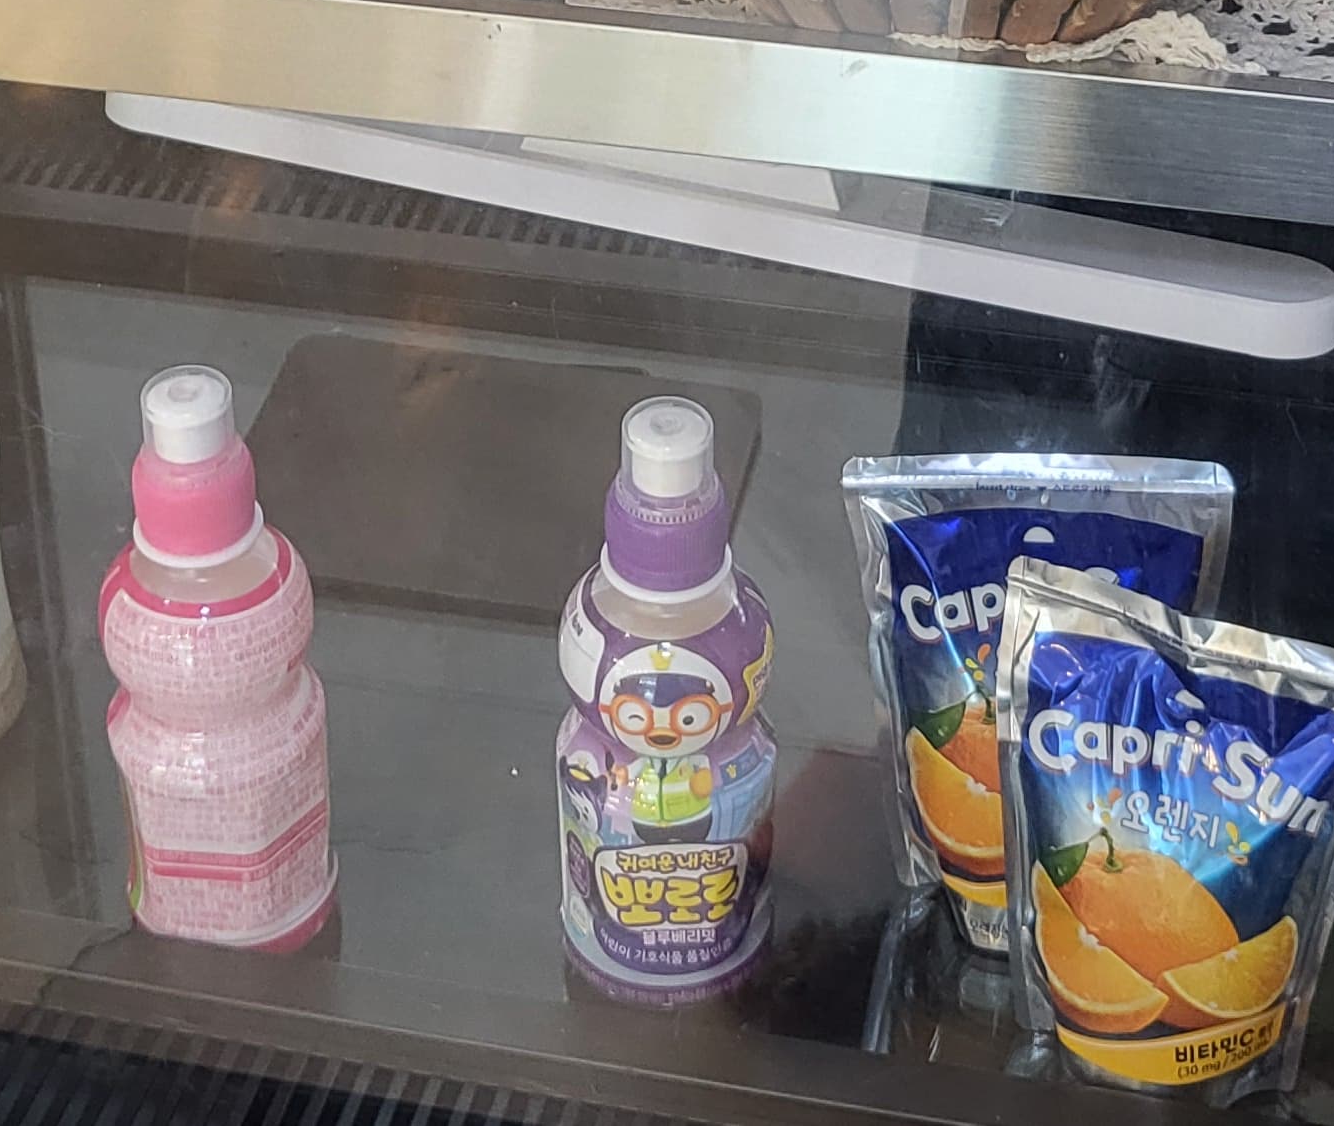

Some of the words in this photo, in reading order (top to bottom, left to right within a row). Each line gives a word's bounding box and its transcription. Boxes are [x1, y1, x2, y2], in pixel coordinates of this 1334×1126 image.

[1122, 790, 1219, 849] 오렌지
[601, 866, 738, 927] 뽀로로
[642, 929, 716, 945] 블루베리맛
[1175, 1028, 1255, 1064] 비타민C
